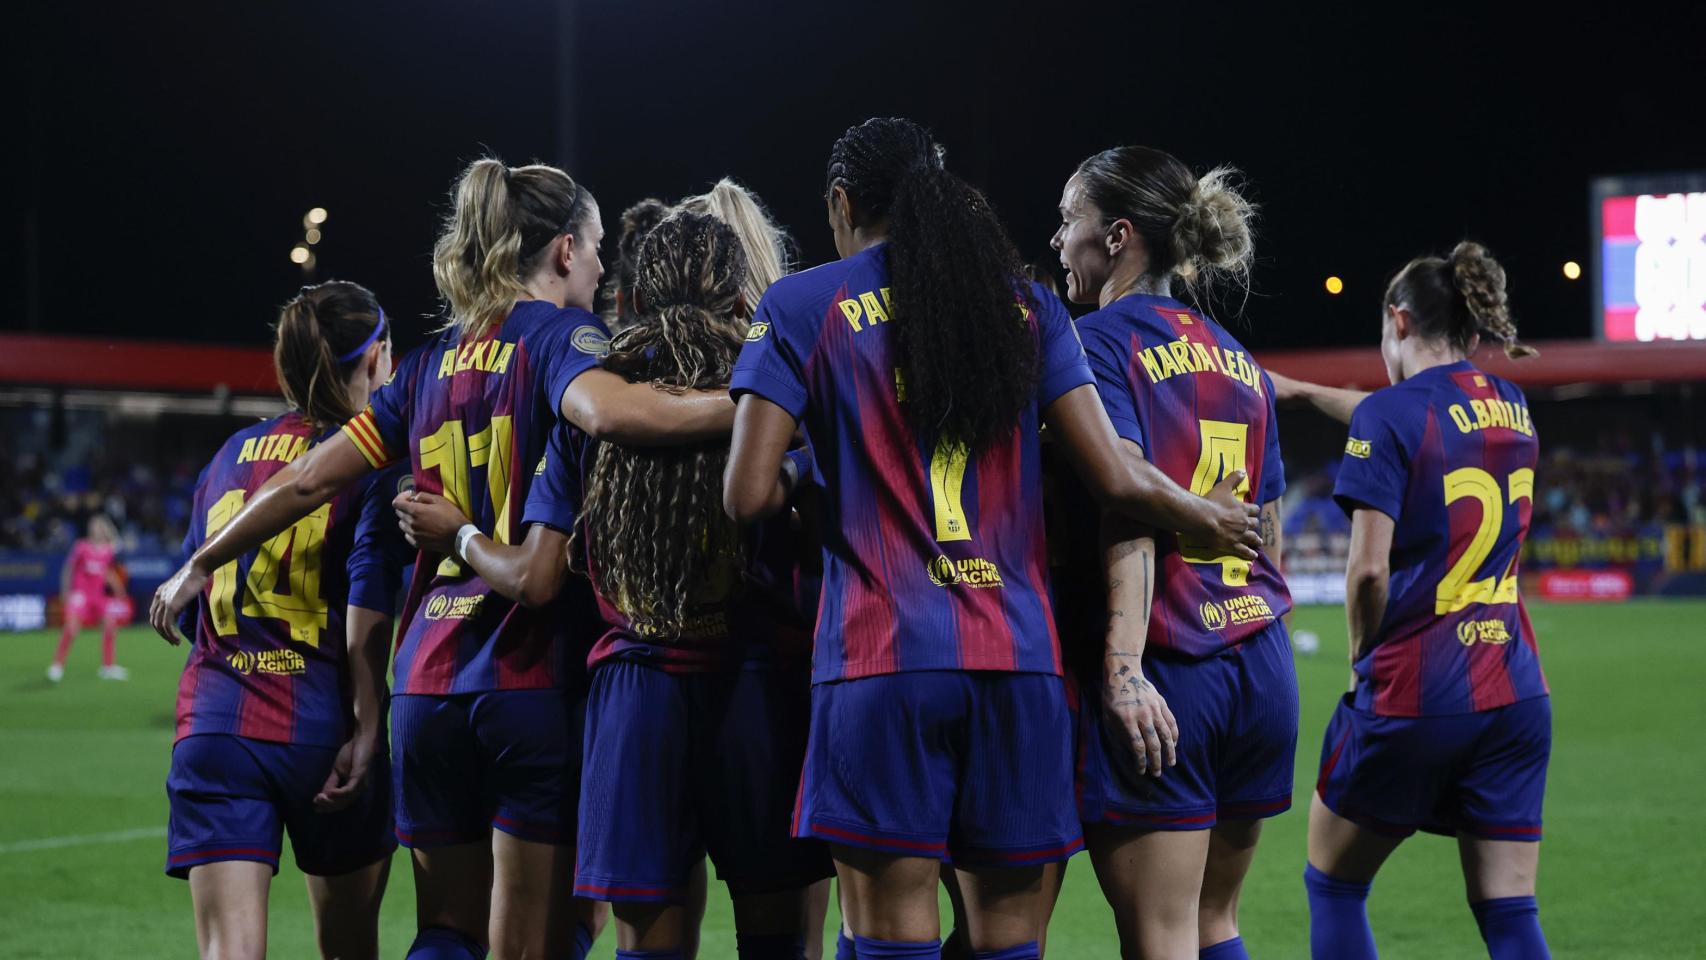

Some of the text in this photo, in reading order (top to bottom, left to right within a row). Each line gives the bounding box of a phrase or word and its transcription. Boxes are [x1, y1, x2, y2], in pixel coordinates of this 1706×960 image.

[236, 434, 311, 464] AITAN
[420, 415, 512, 577] 11
[206, 489, 332, 648] 14
[1224, 595, 1267, 610] UNHCR
[1230, 605, 1273, 621] ACNUR
[257, 659, 305, 671] ACNUR
